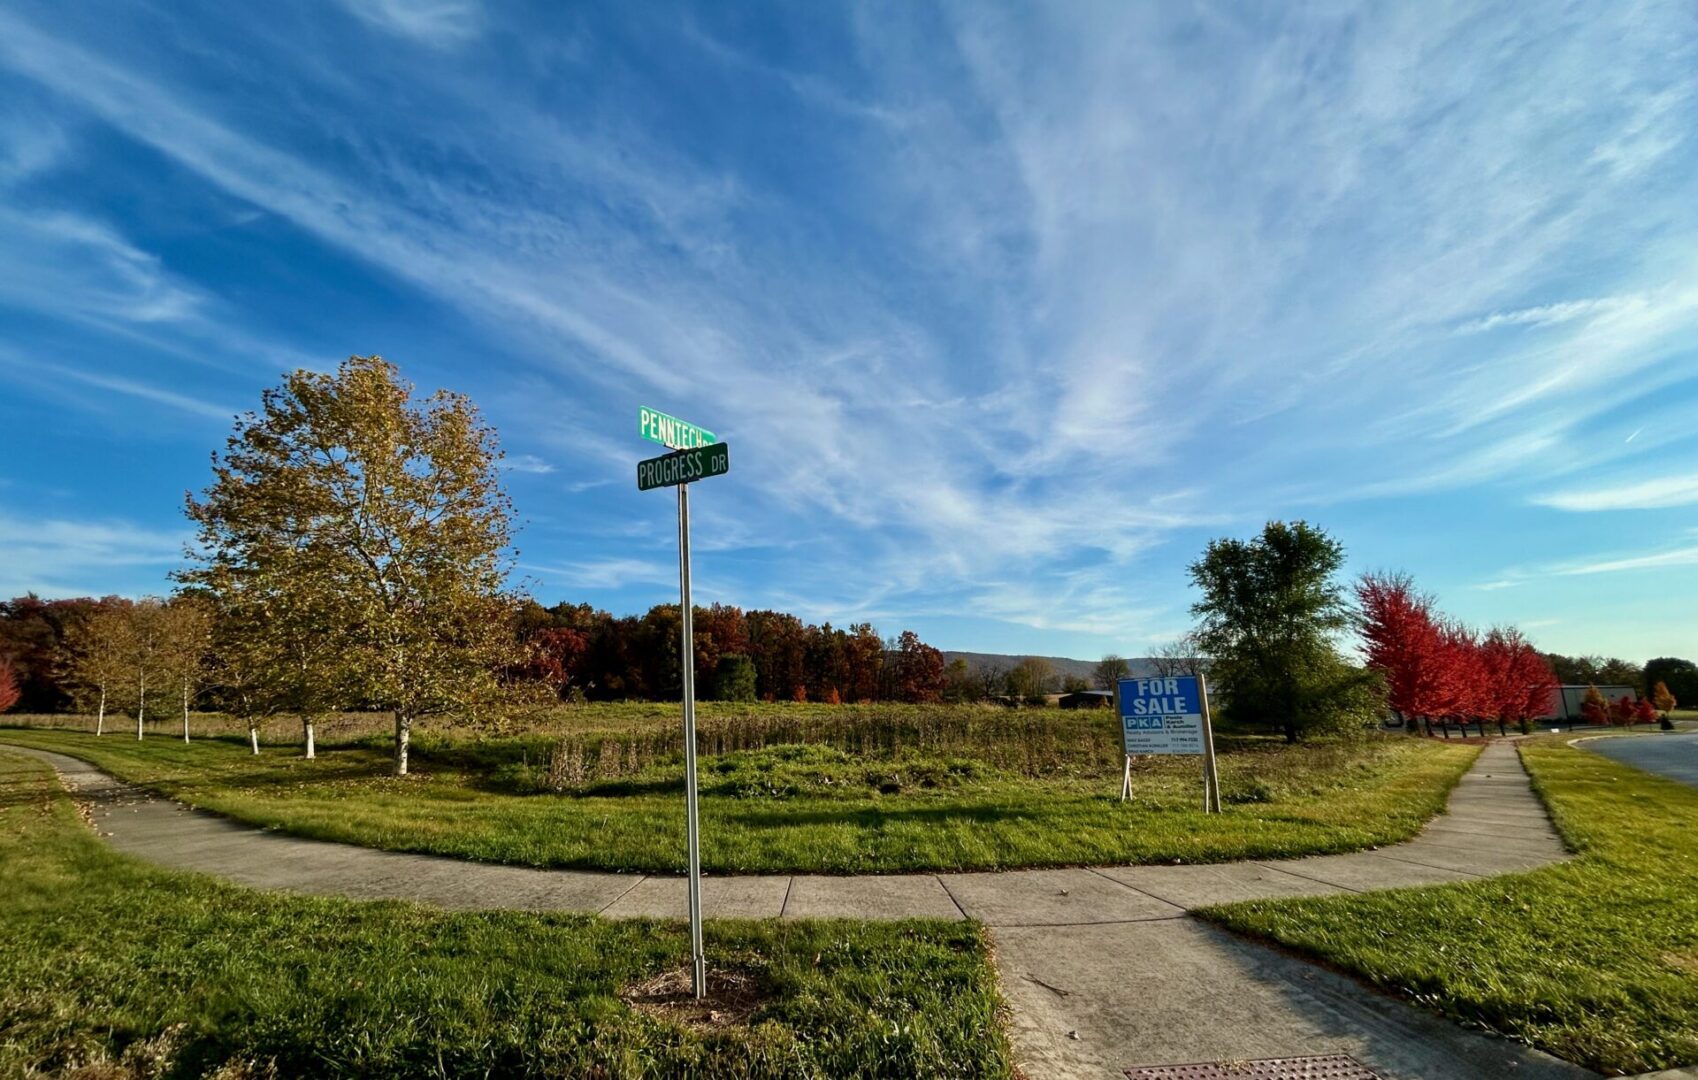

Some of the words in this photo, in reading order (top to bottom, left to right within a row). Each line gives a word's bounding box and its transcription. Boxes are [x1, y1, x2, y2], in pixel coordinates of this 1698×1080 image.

[641, 409, 702, 449] PENNTECH
[640, 451, 703, 488] PROGRESS
[711, 454, 727, 473] DR
[1138, 679, 1179, 696] FOR
[1133, 697, 1188, 715] SALE
[1126, 718, 1163, 728] PKA
